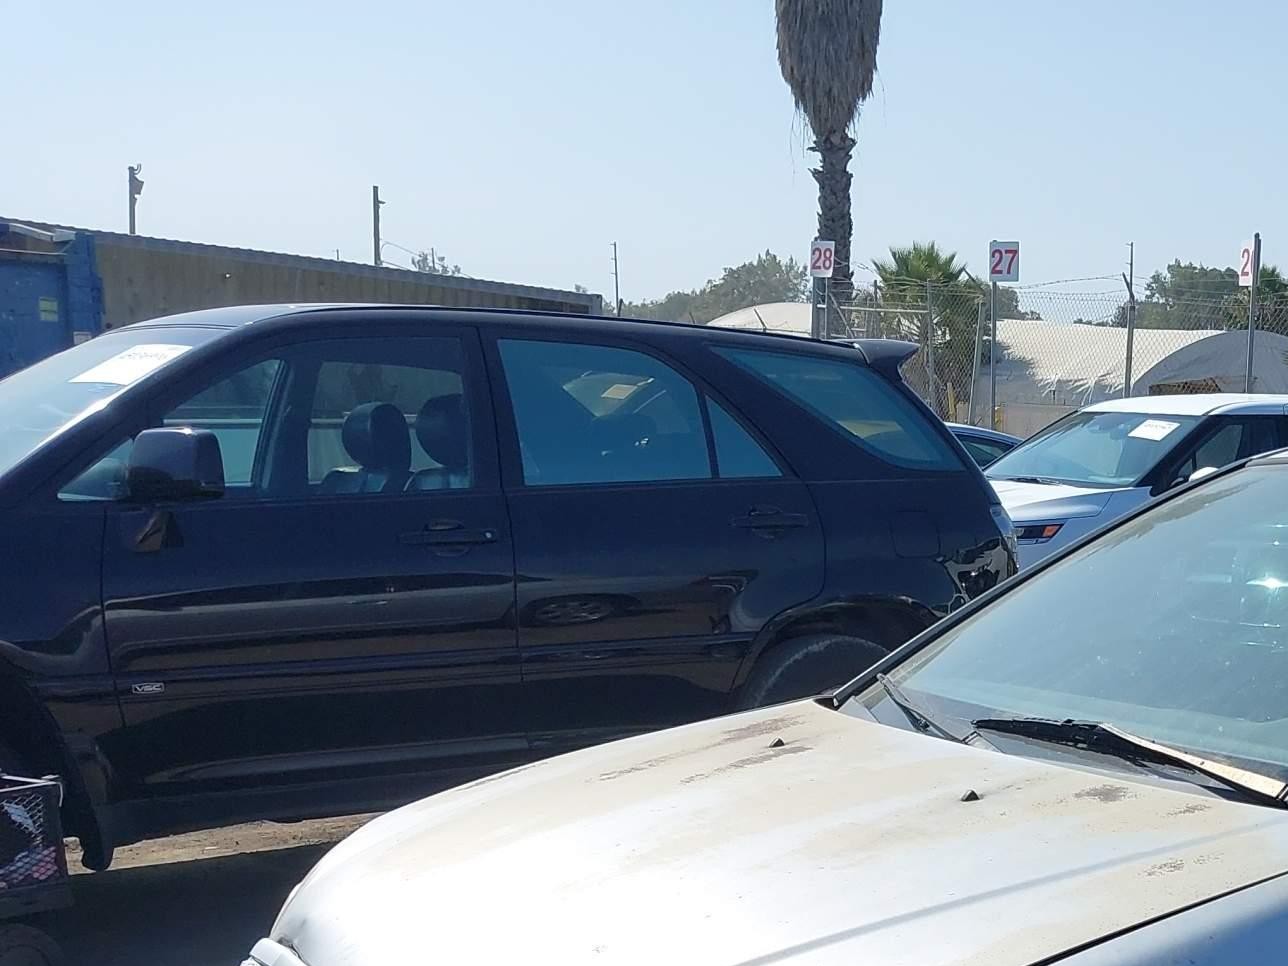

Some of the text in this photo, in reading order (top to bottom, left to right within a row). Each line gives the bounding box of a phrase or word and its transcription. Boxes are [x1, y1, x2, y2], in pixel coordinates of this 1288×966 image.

[811, 247, 833, 270] 28
[991, 249, 1018, 275] 27
[1240, 248, 1254, 276] 2
